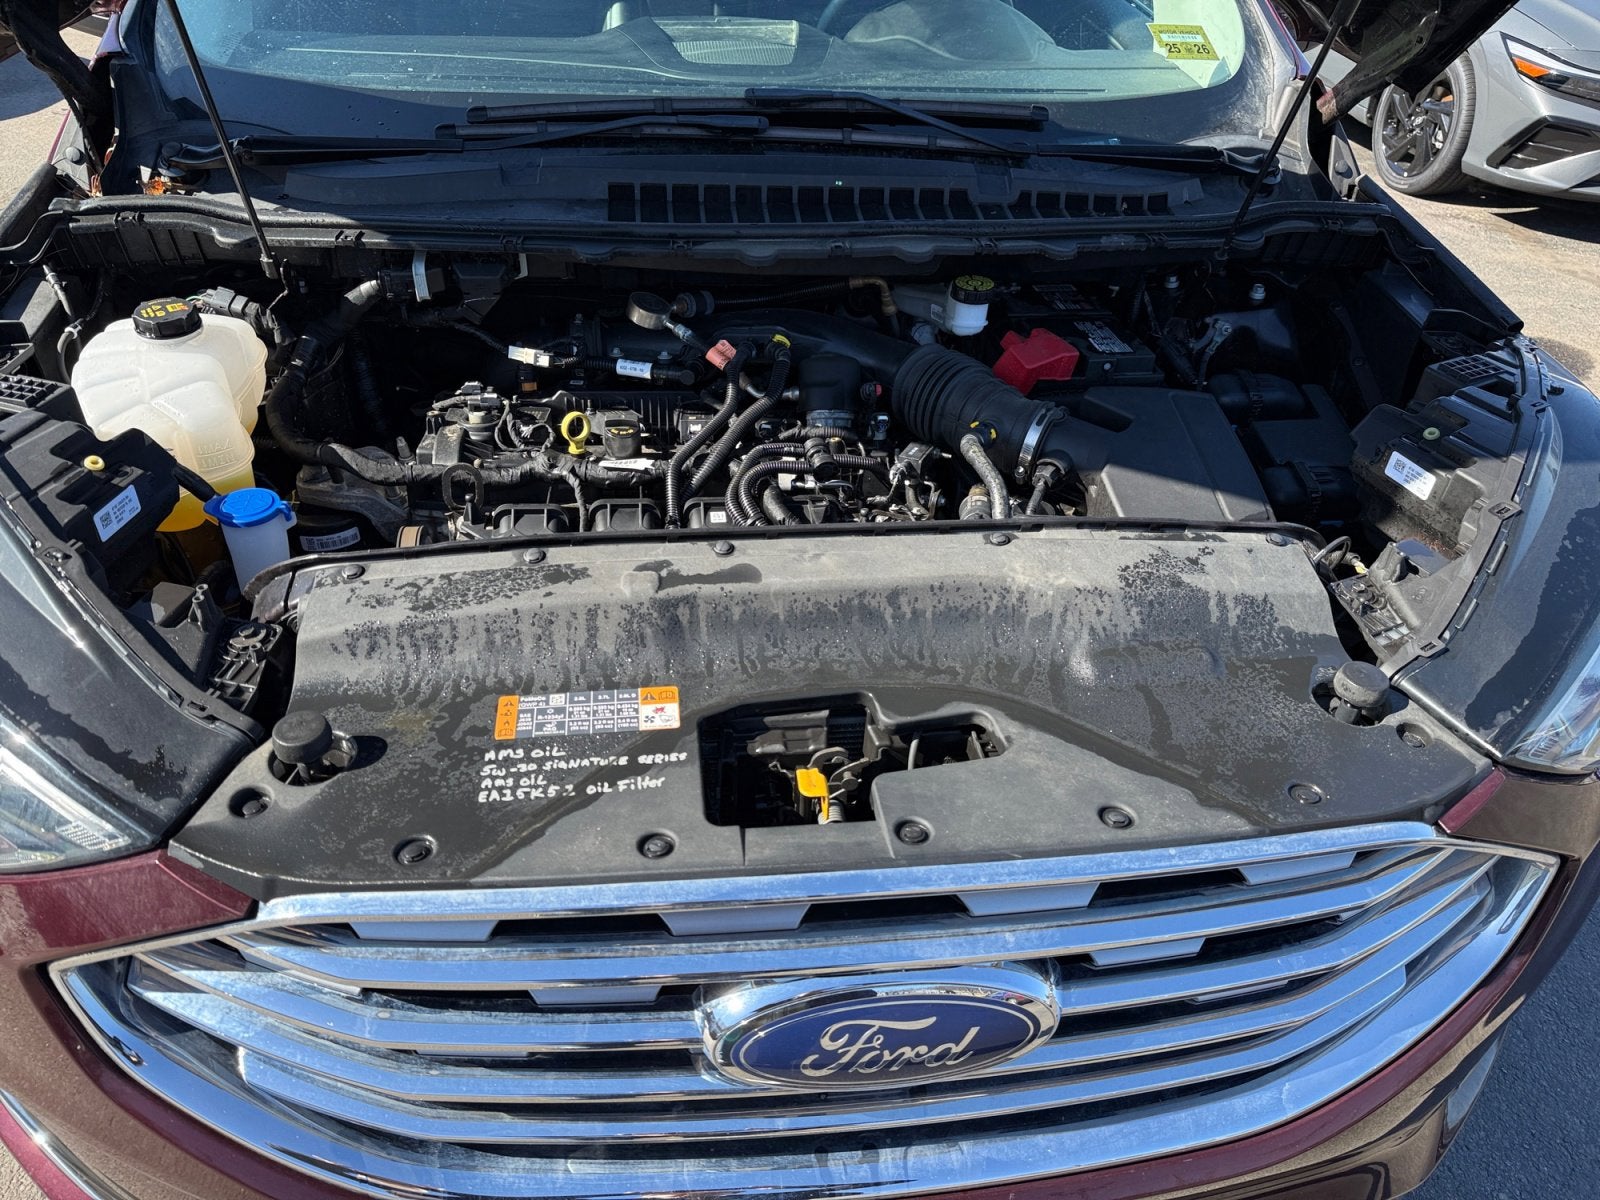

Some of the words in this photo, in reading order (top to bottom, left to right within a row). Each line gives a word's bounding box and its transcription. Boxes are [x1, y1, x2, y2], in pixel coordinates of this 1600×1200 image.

[1165, 43, 1181, 54] 25
[1193, 44, 1210, 54] 26
[800, 1016, 981, 1078] Ford
